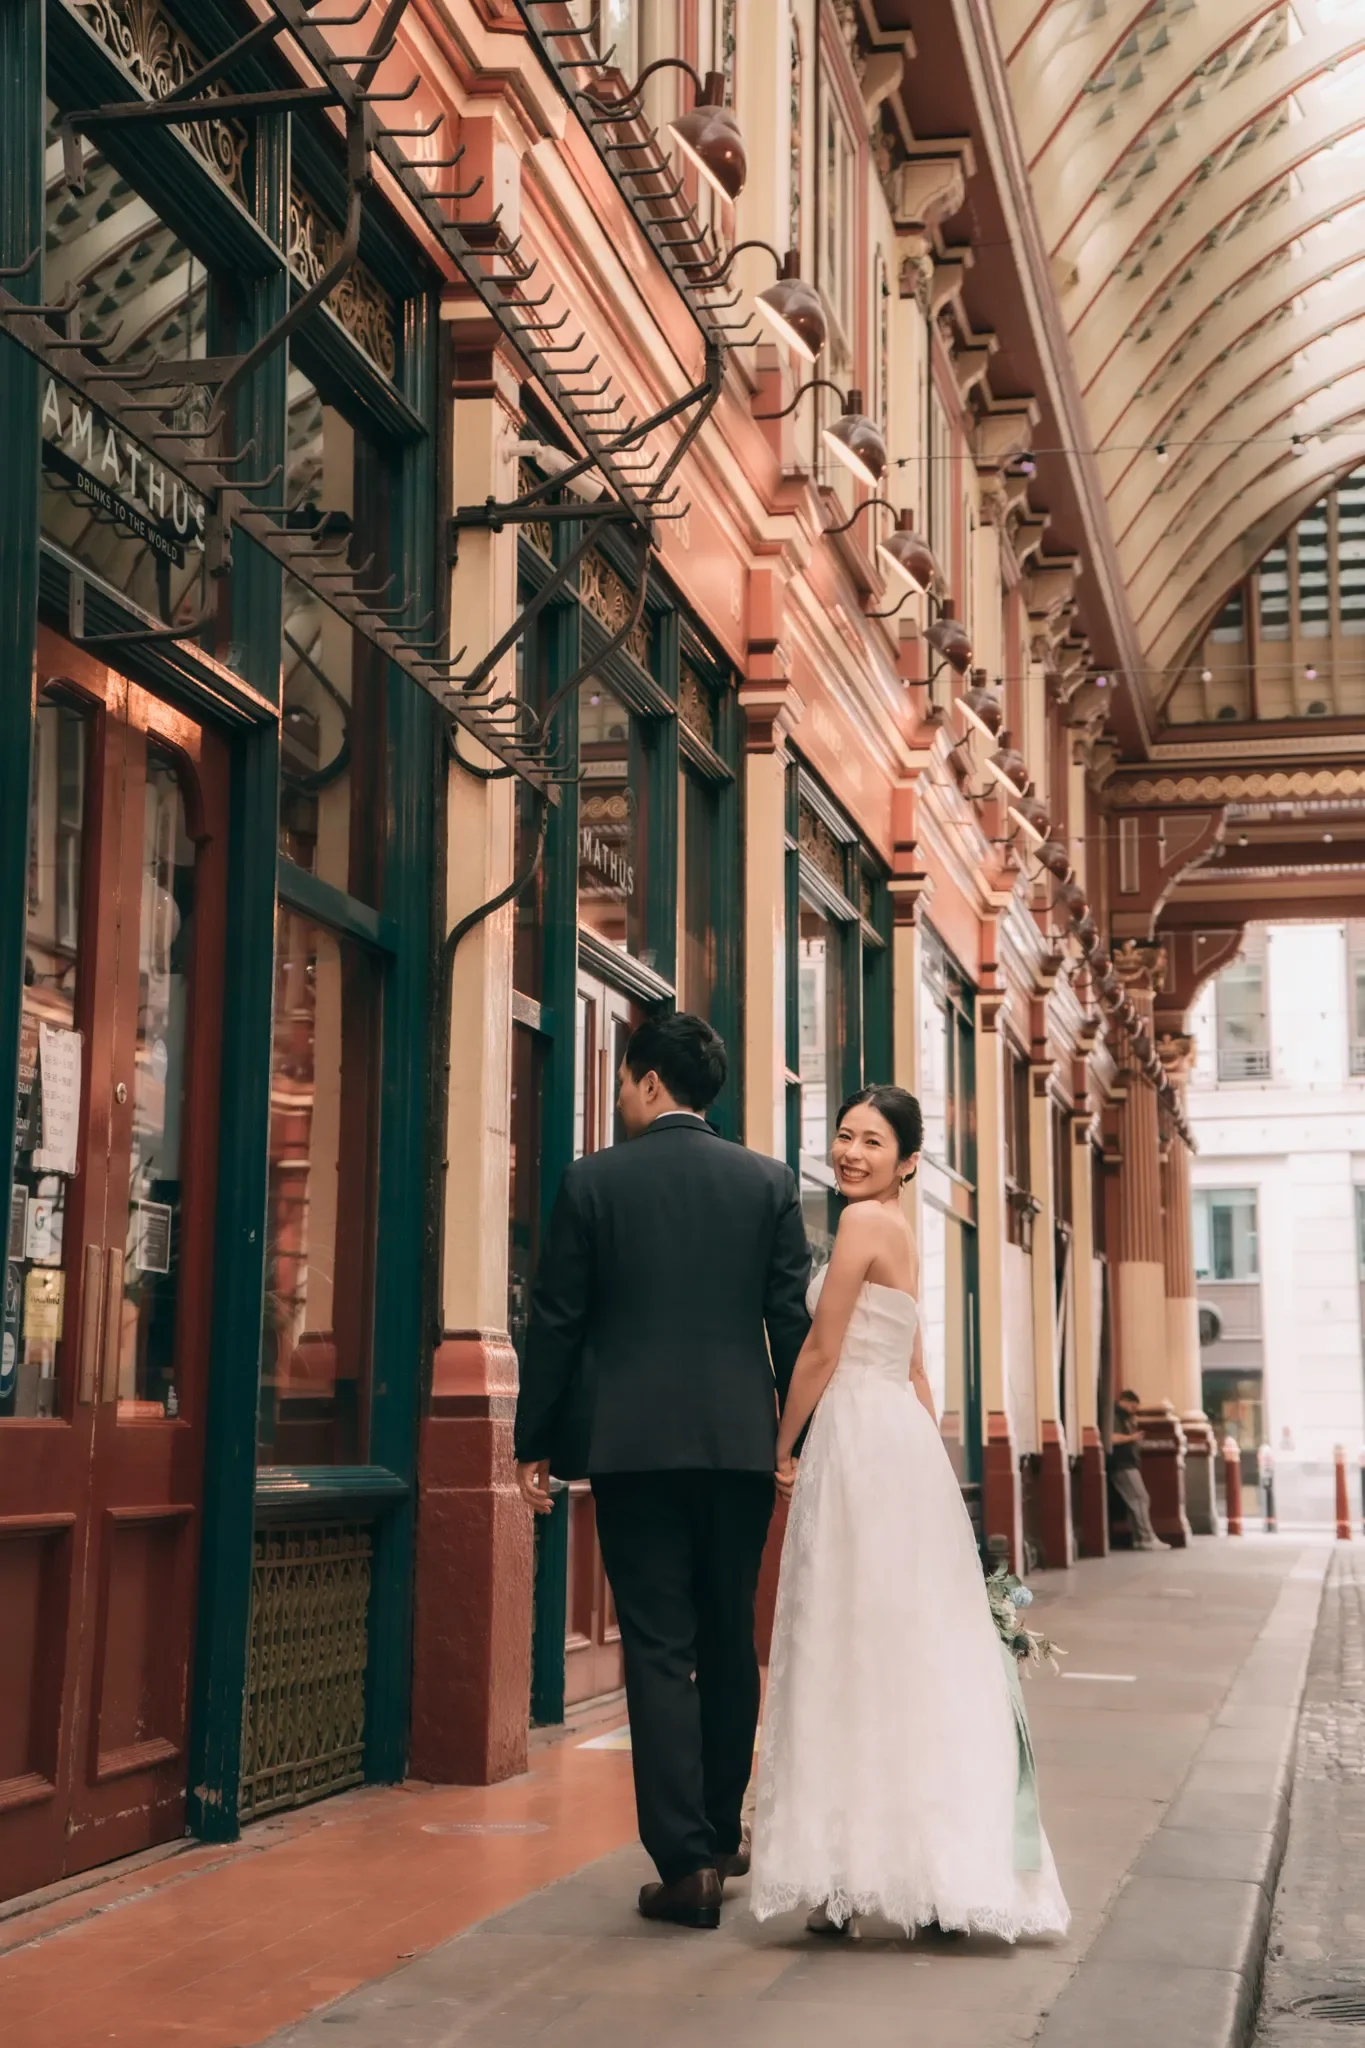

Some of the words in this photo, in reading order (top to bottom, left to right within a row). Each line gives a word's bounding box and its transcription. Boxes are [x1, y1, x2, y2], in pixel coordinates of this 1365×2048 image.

[77, 472, 111, 510] DRINKS
[114, 500, 126, 520] TO
[128, 511, 146, 536] THE
[148, 527, 178, 561] WORLD
[579, 829, 634, 896] MATHUS
